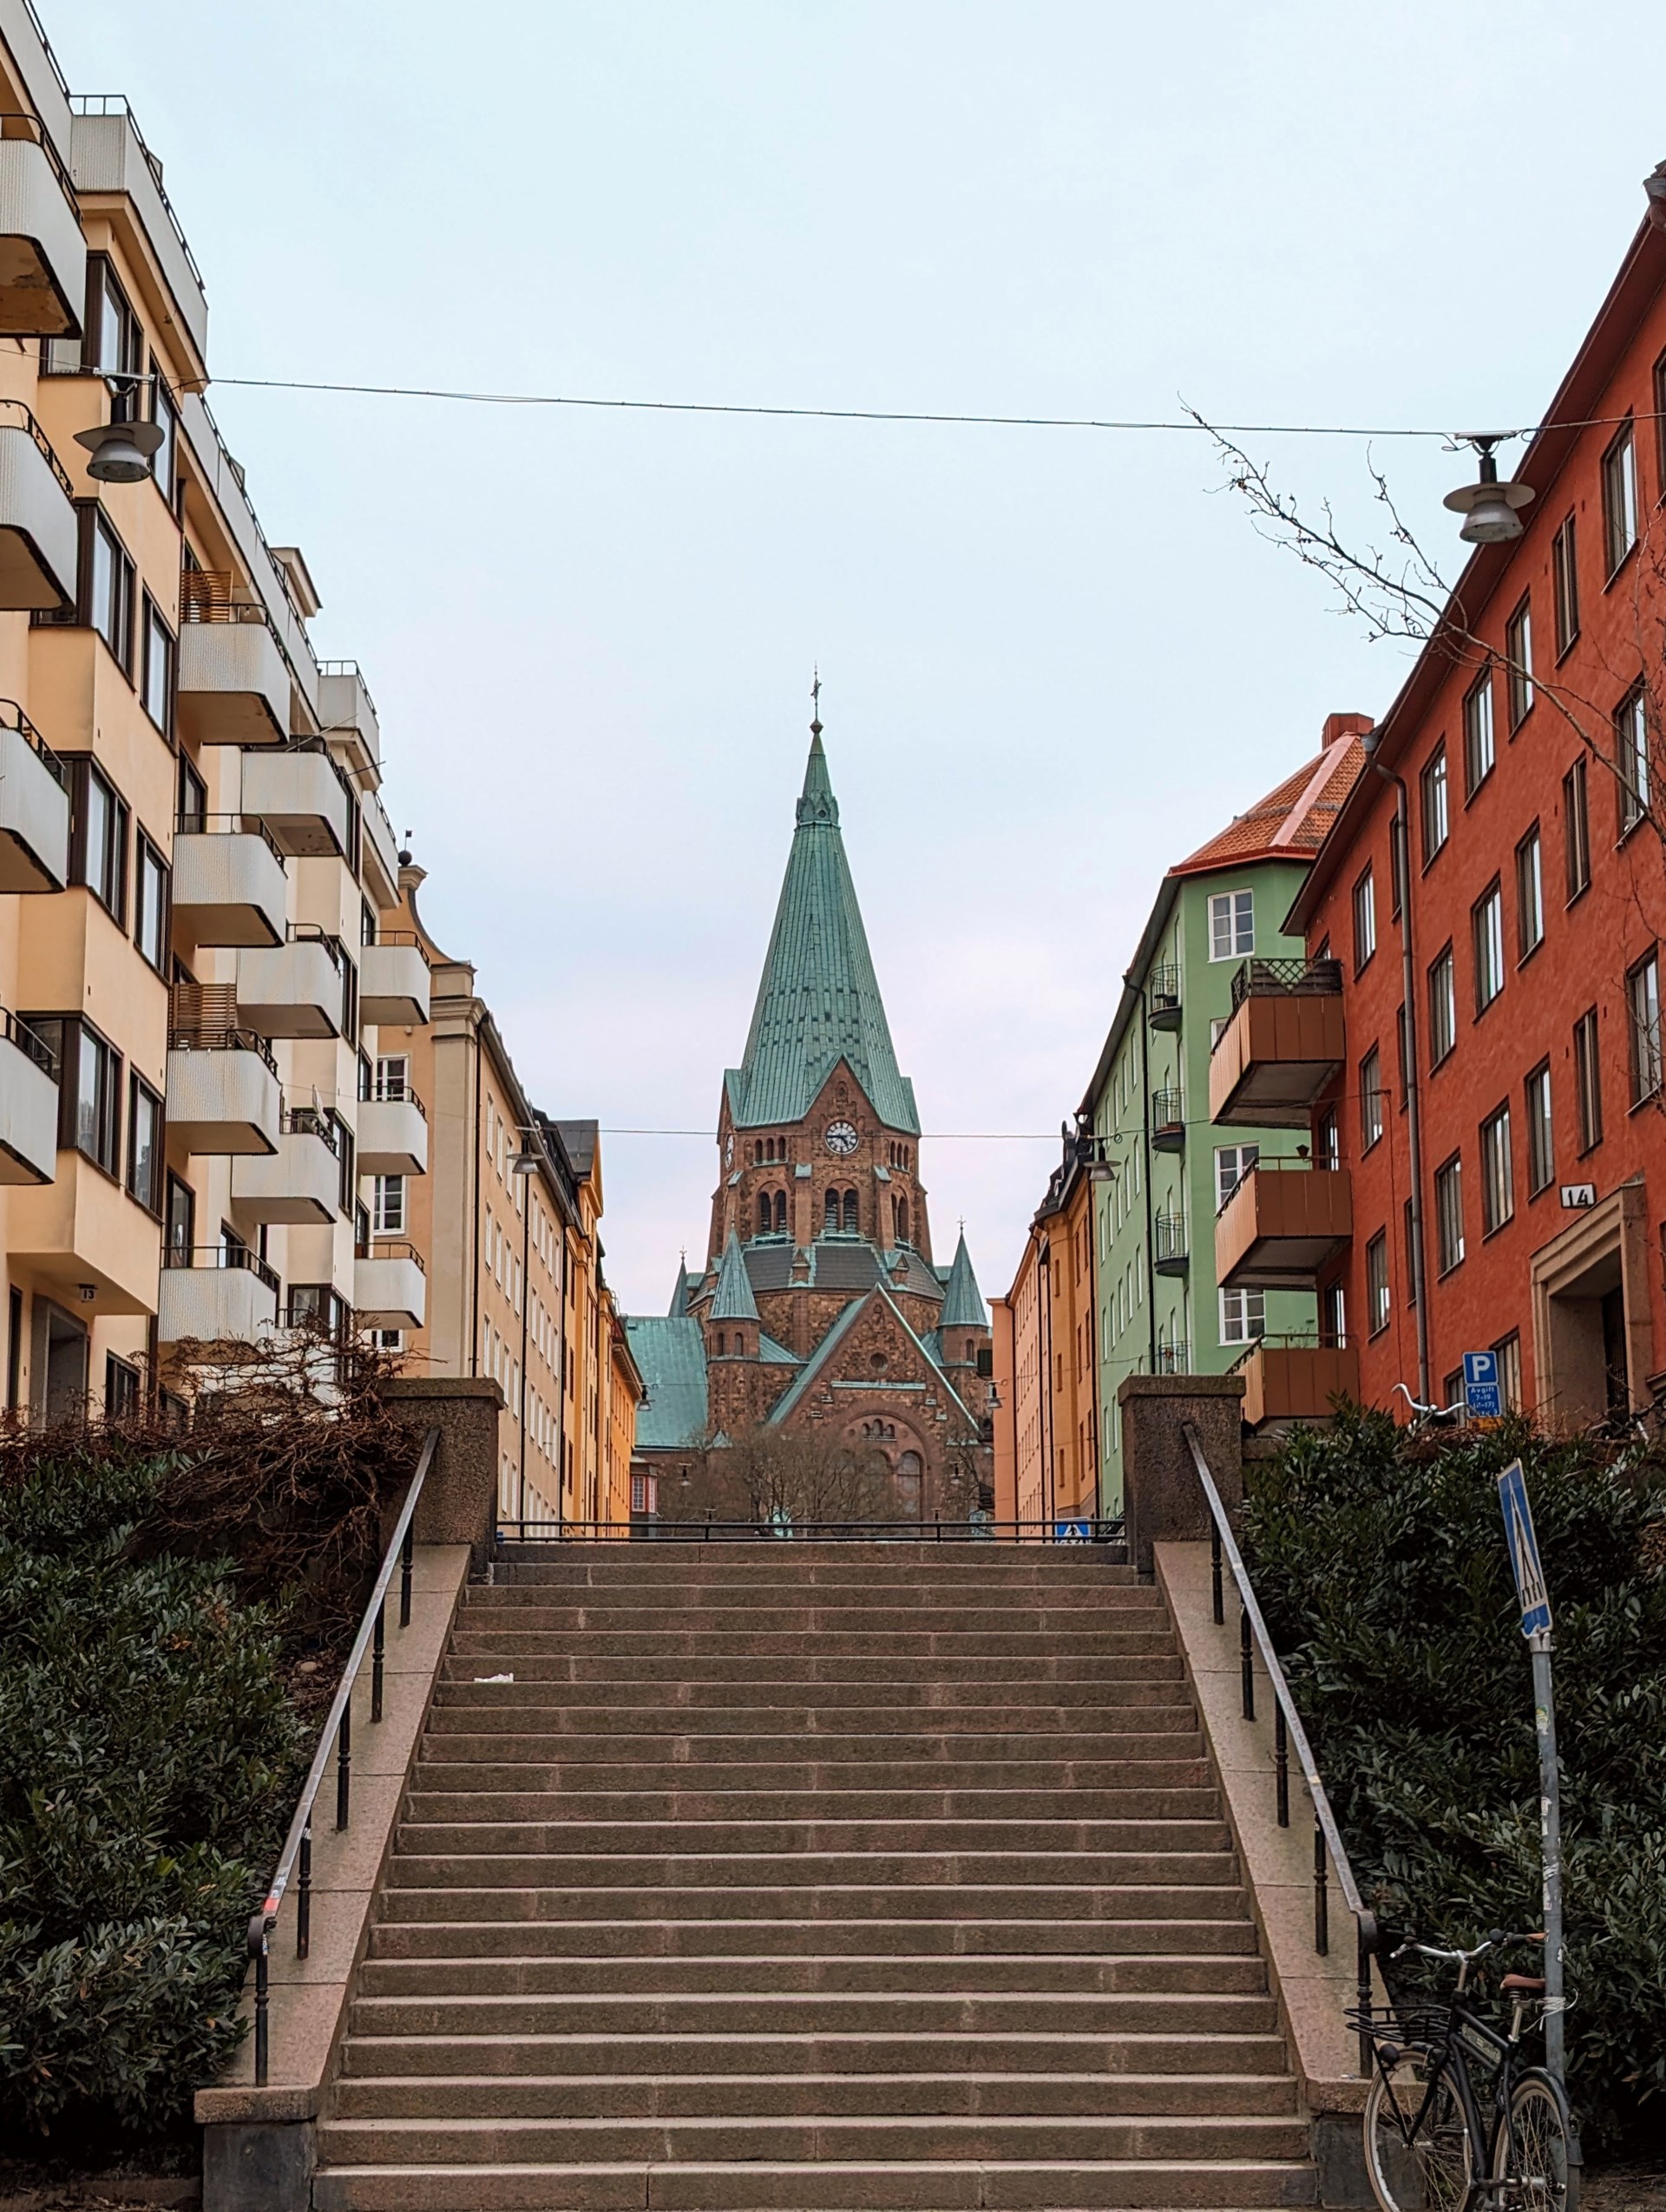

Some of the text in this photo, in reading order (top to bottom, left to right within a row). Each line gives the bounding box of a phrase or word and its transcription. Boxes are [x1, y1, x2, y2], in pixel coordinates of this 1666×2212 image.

[1568, 1188, 1589, 1207] 14
[84, 1290, 95, 1299] 13
[1472, 1355, 1491, 1382] P
